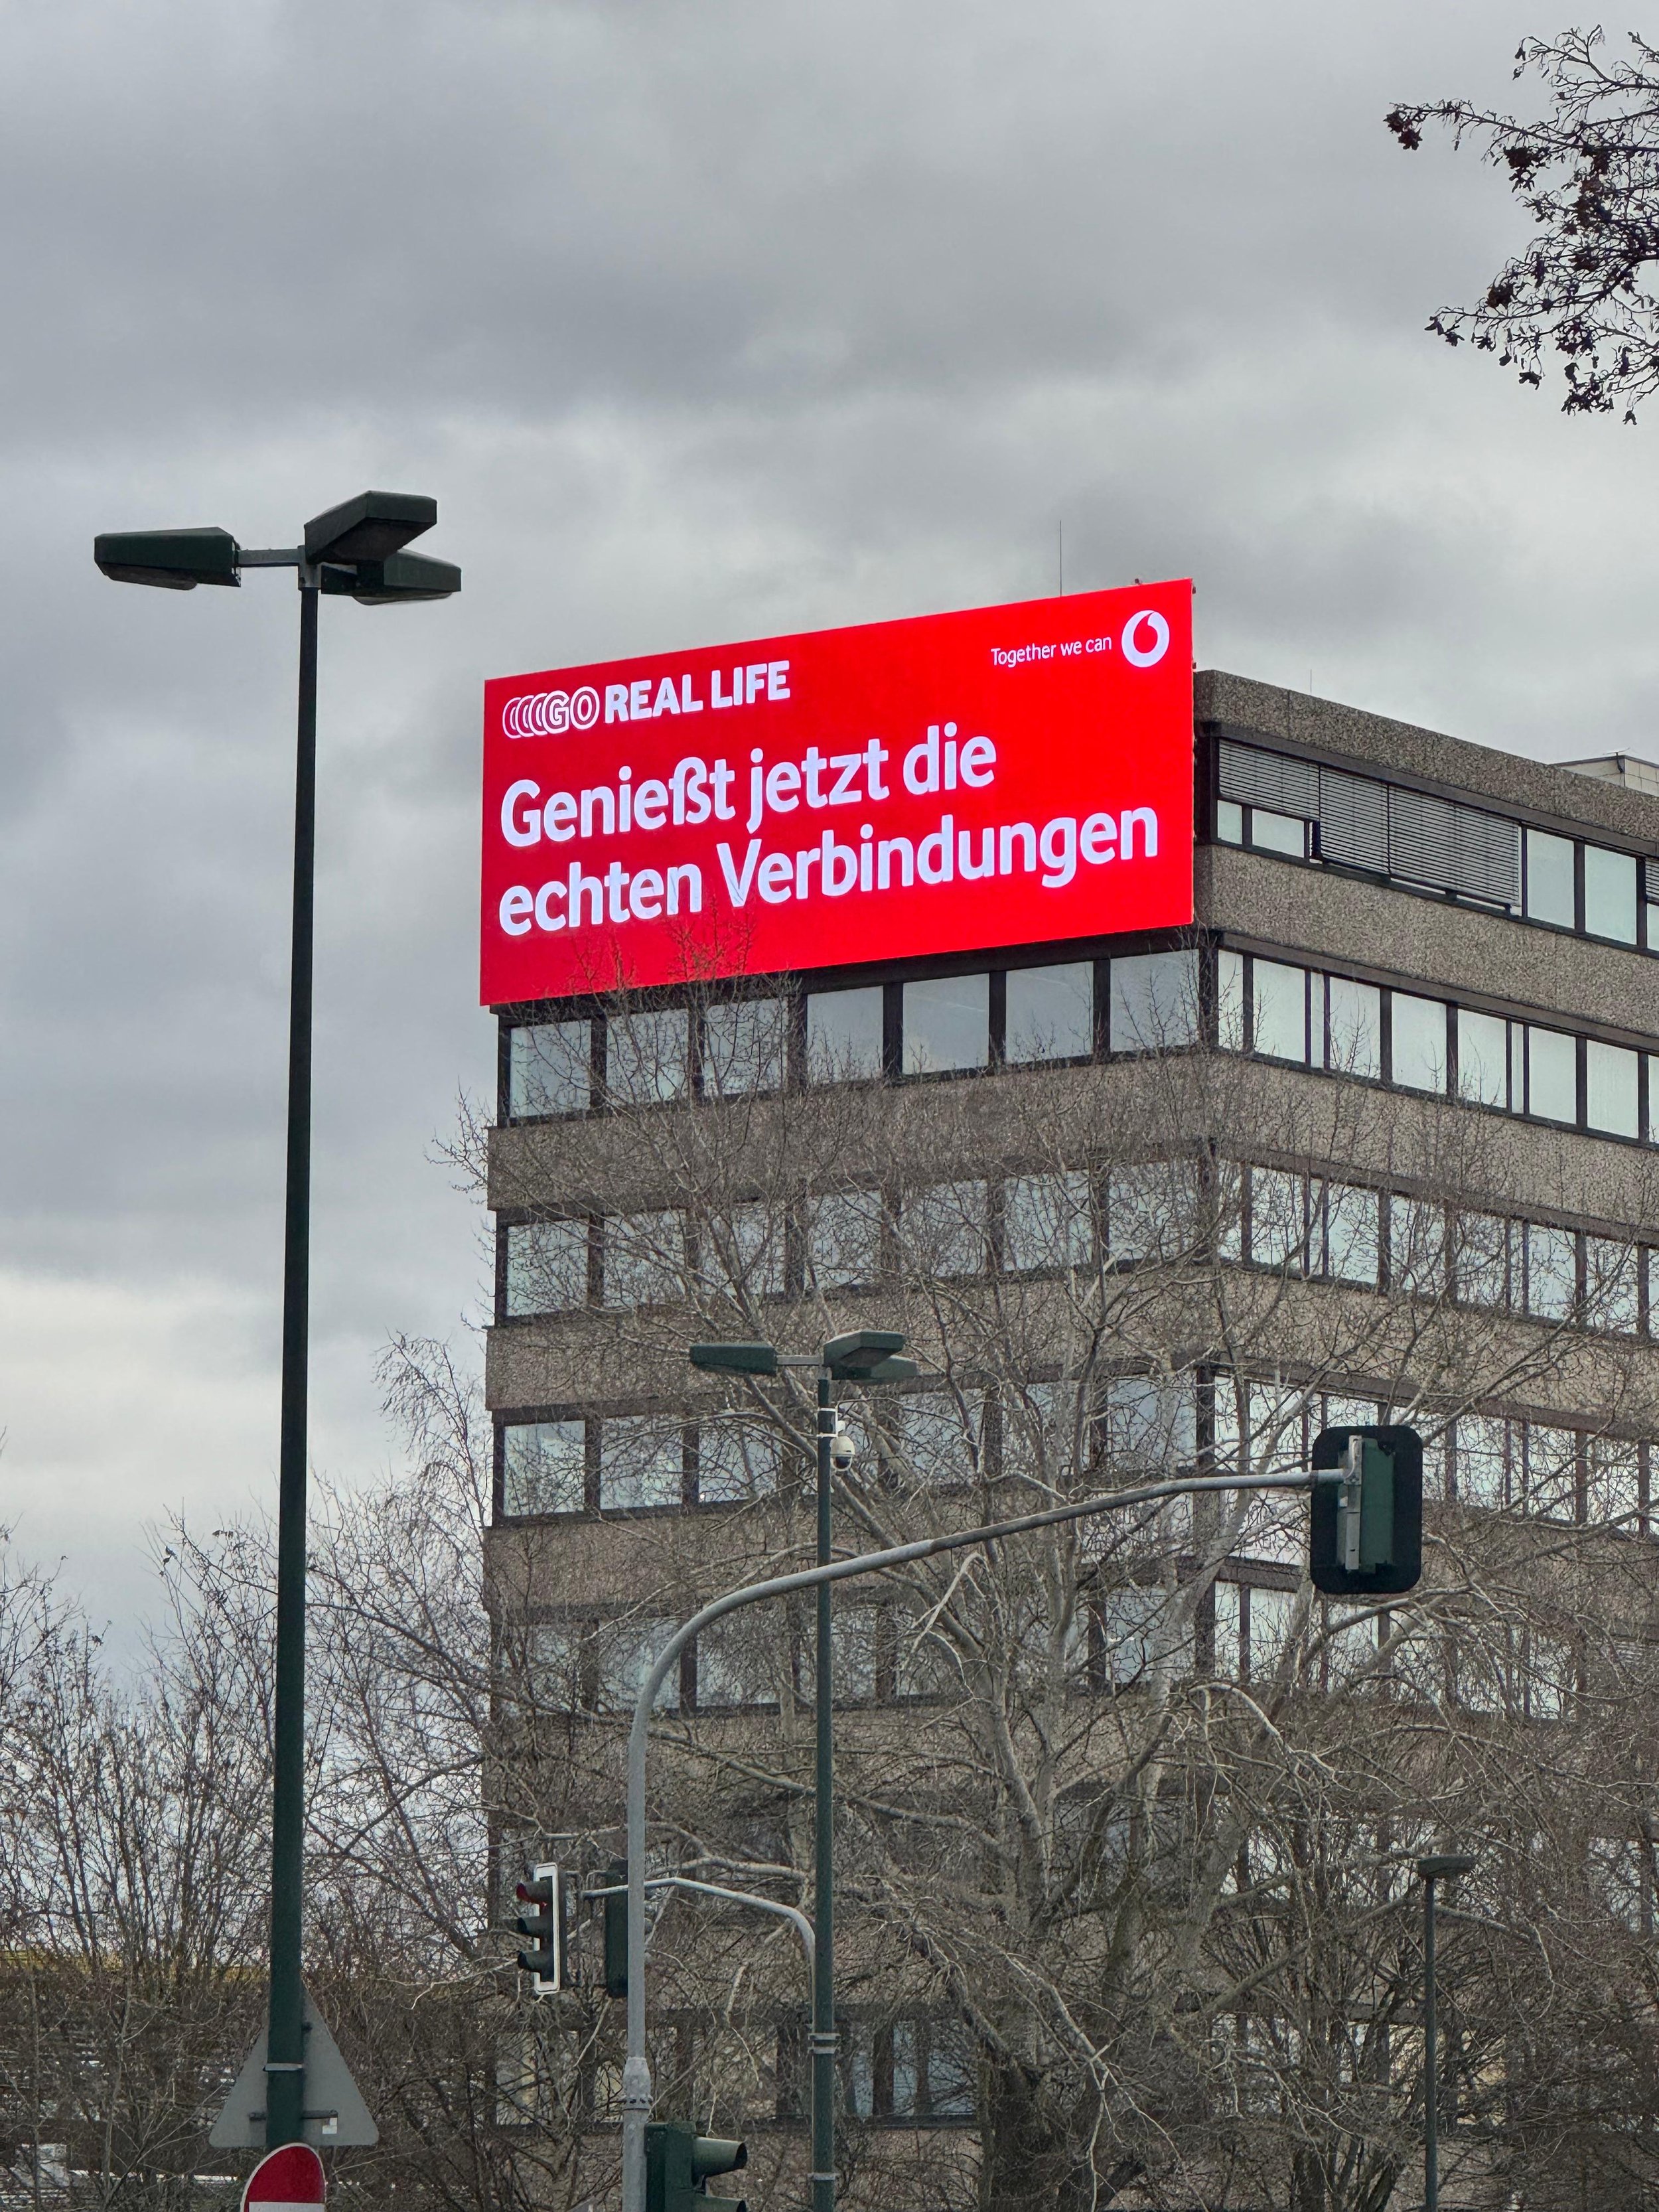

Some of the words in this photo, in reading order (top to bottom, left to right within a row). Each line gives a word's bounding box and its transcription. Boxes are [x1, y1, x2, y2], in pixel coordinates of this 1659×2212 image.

[604, 673, 704, 724] REAL
[711, 660, 791, 709] LIFE
[990, 642, 1057, 668] Together
[1060, 640, 1082, 656] we
[1085, 637, 1112, 653] can
[500, 756, 737, 848] Genießt
[745, 737, 891, 835] jetzt
[902, 721, 997, 796] die
[498, 861, 703, 936] echten
[715, 806, 1159, 908] Verbindungen
